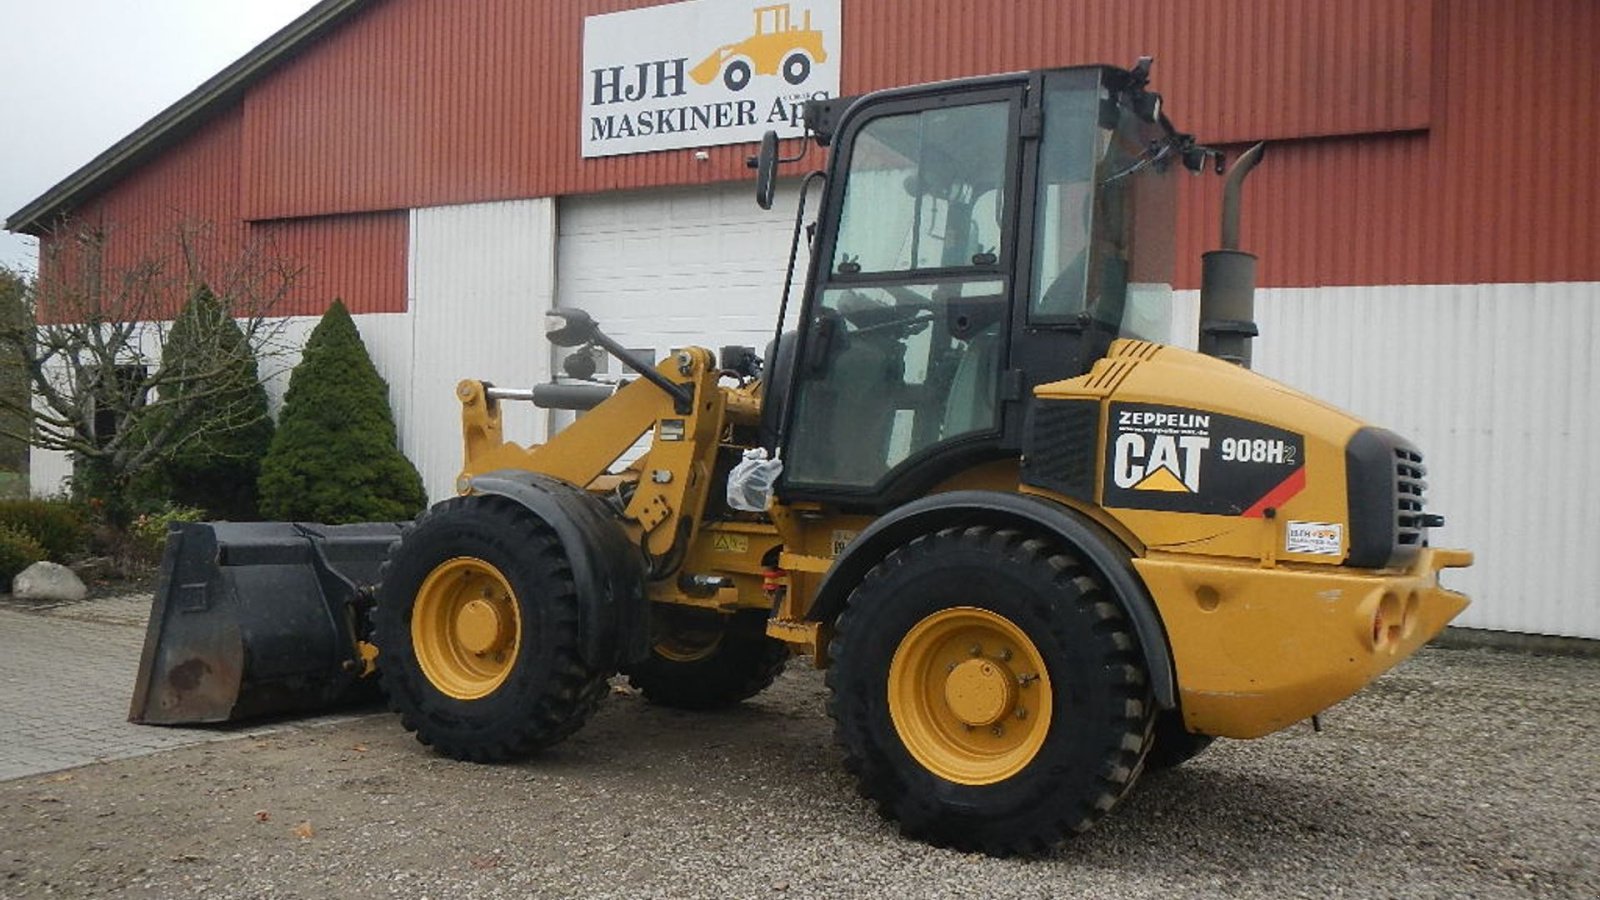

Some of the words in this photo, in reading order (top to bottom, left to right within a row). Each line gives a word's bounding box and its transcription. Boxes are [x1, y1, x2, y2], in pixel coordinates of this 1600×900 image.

[591, 58, 688, 105] HJH
[591, 100, 758, 141] MASKINER
[1119, 411, 1210, 428] ZEPPELIN
[1114, 432, 1210, 494] CAT
